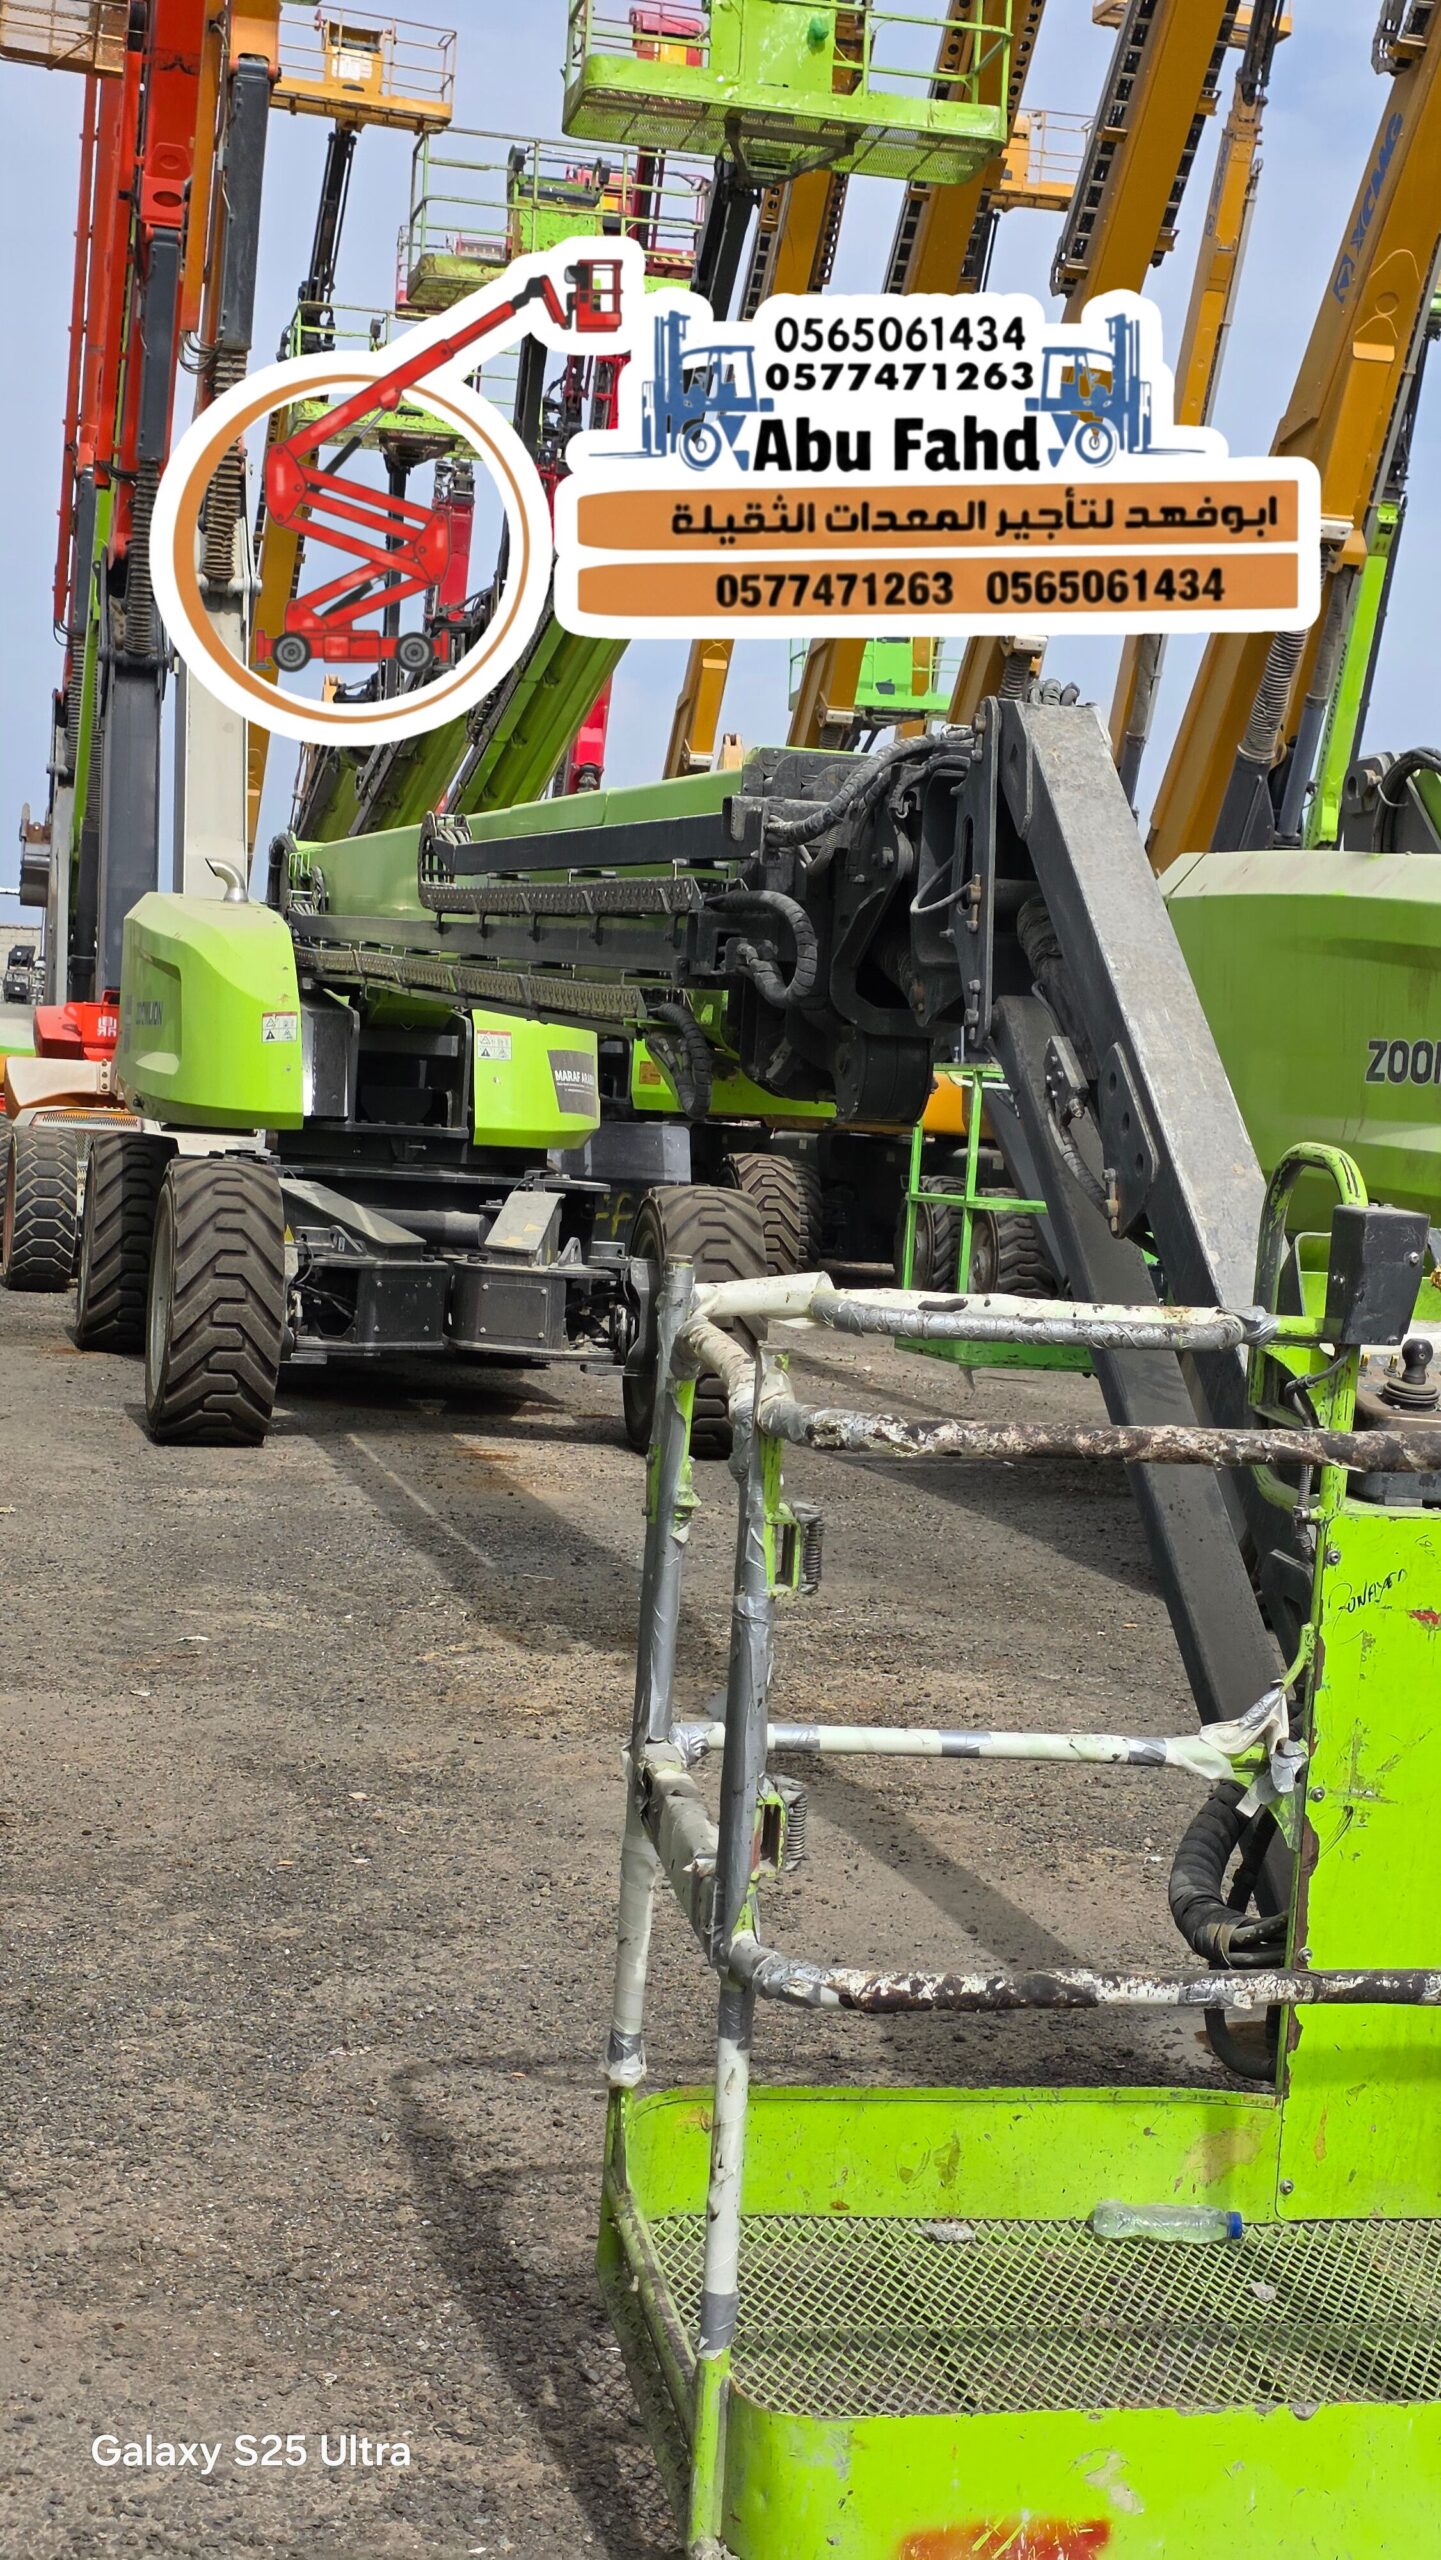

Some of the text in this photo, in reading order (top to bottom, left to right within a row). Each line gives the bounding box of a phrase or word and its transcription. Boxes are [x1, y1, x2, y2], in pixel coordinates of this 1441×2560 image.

[1349, 111, 1403, 256] XCMG
[1324, 642, 1348, 745] ZOOMLION
[1365, 1039, 1441, 1084] ZOO
